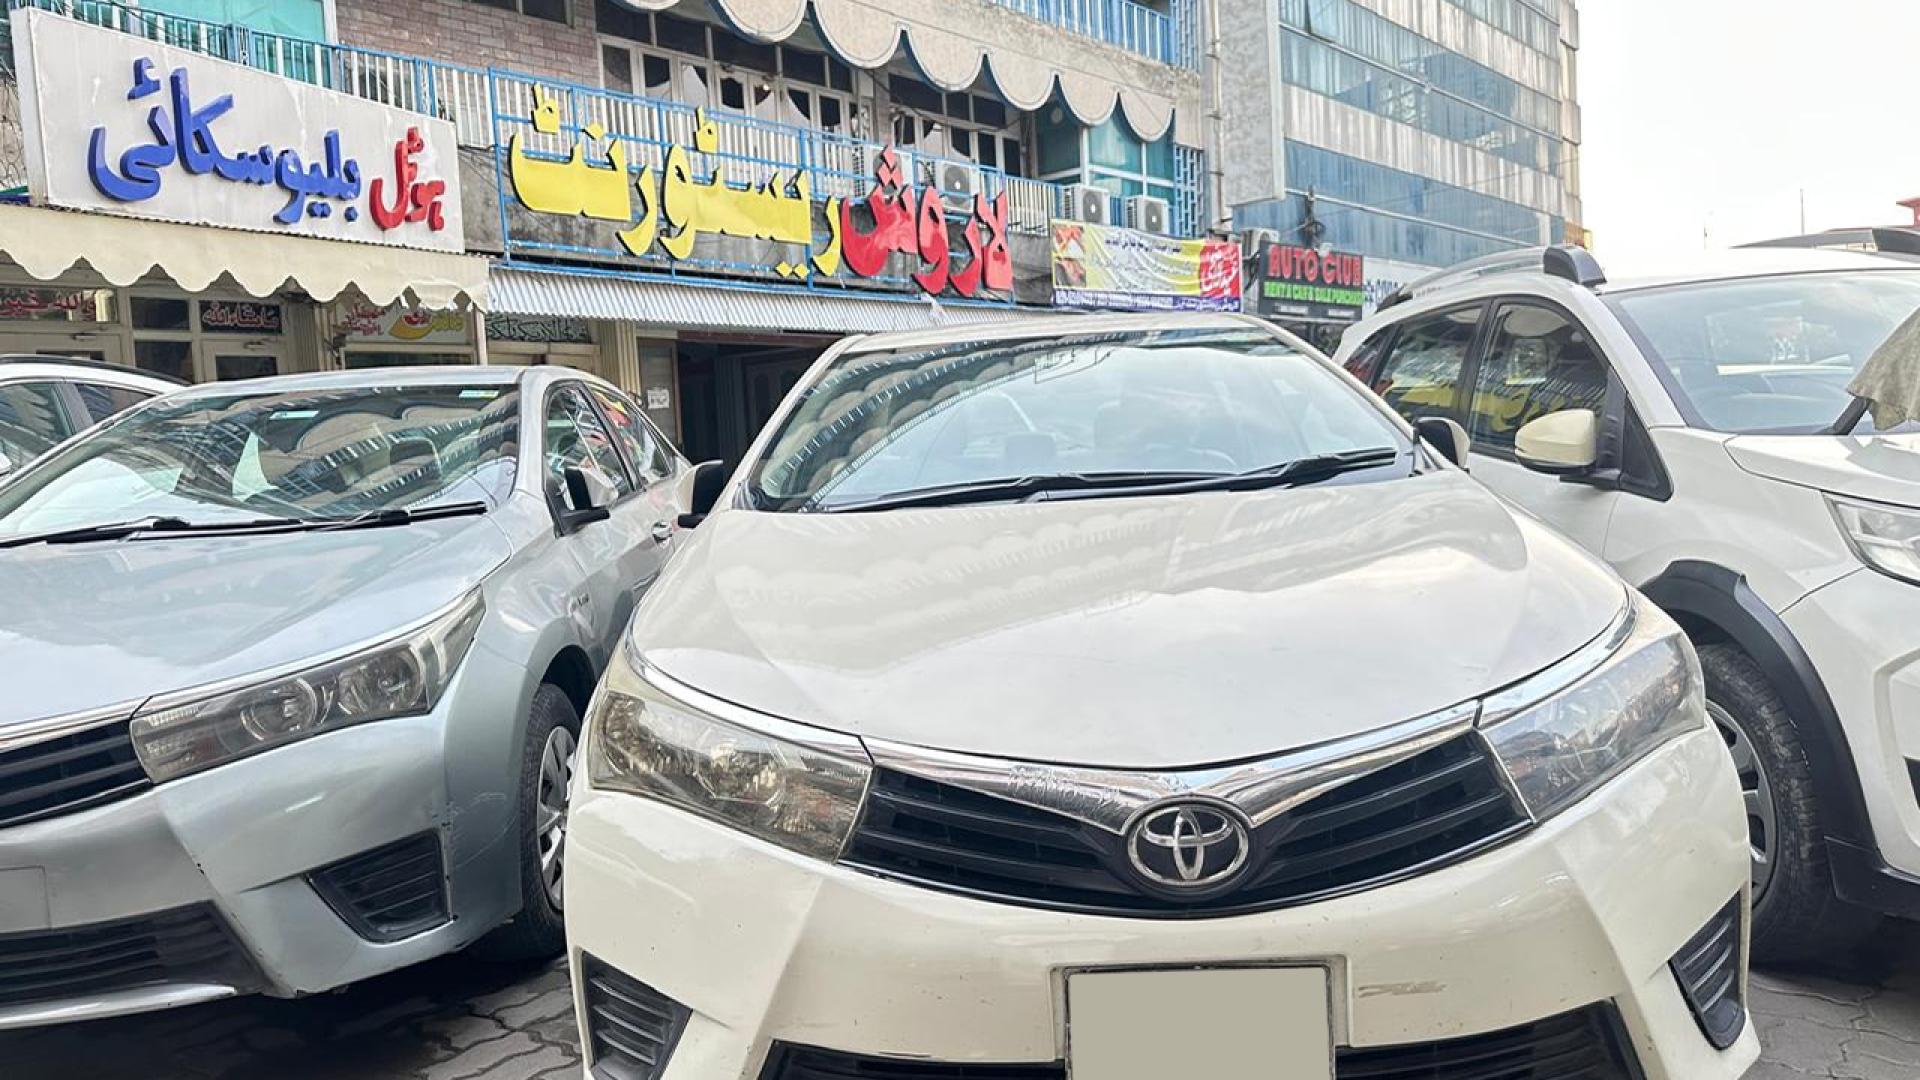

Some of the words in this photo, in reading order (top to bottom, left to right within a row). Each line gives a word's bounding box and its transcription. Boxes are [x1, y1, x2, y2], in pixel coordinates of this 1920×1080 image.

[369, 127, 446, 232] ہوٹل
[510, 83, 842, 276] ریسٹورنٹ
[1268, 243, 1319, 282] AUTO
[1322, 250, 1363, 286] CLUB
